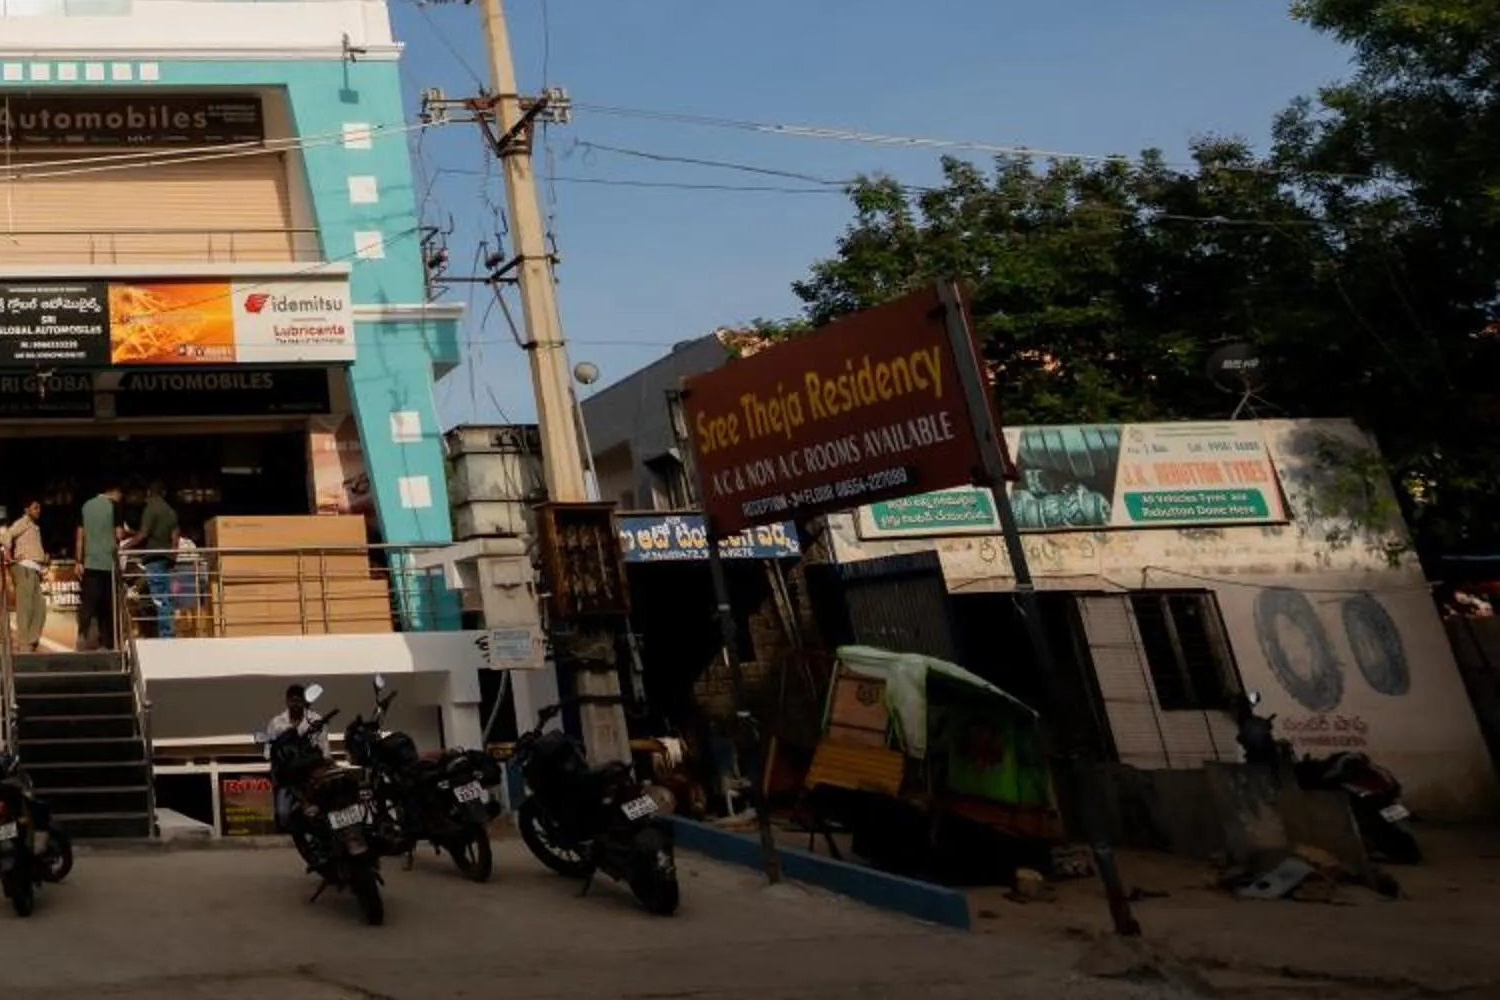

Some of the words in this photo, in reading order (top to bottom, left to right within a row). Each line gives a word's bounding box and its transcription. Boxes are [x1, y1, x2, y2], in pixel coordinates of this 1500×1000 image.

[271, 295, 343, 313] idemitsu
[273, 323, 346, 336] Lubricants
[129, 371, 274, 392] AUTOMOBILES
[696, 410, 741, 455] Sree
[740, 381, 805, 441] Theja
[804, 344, 944, 421] Residency
[804, 433, 862, 474] ROOMS
[862, 410, 955, 458] AVAILABLE
